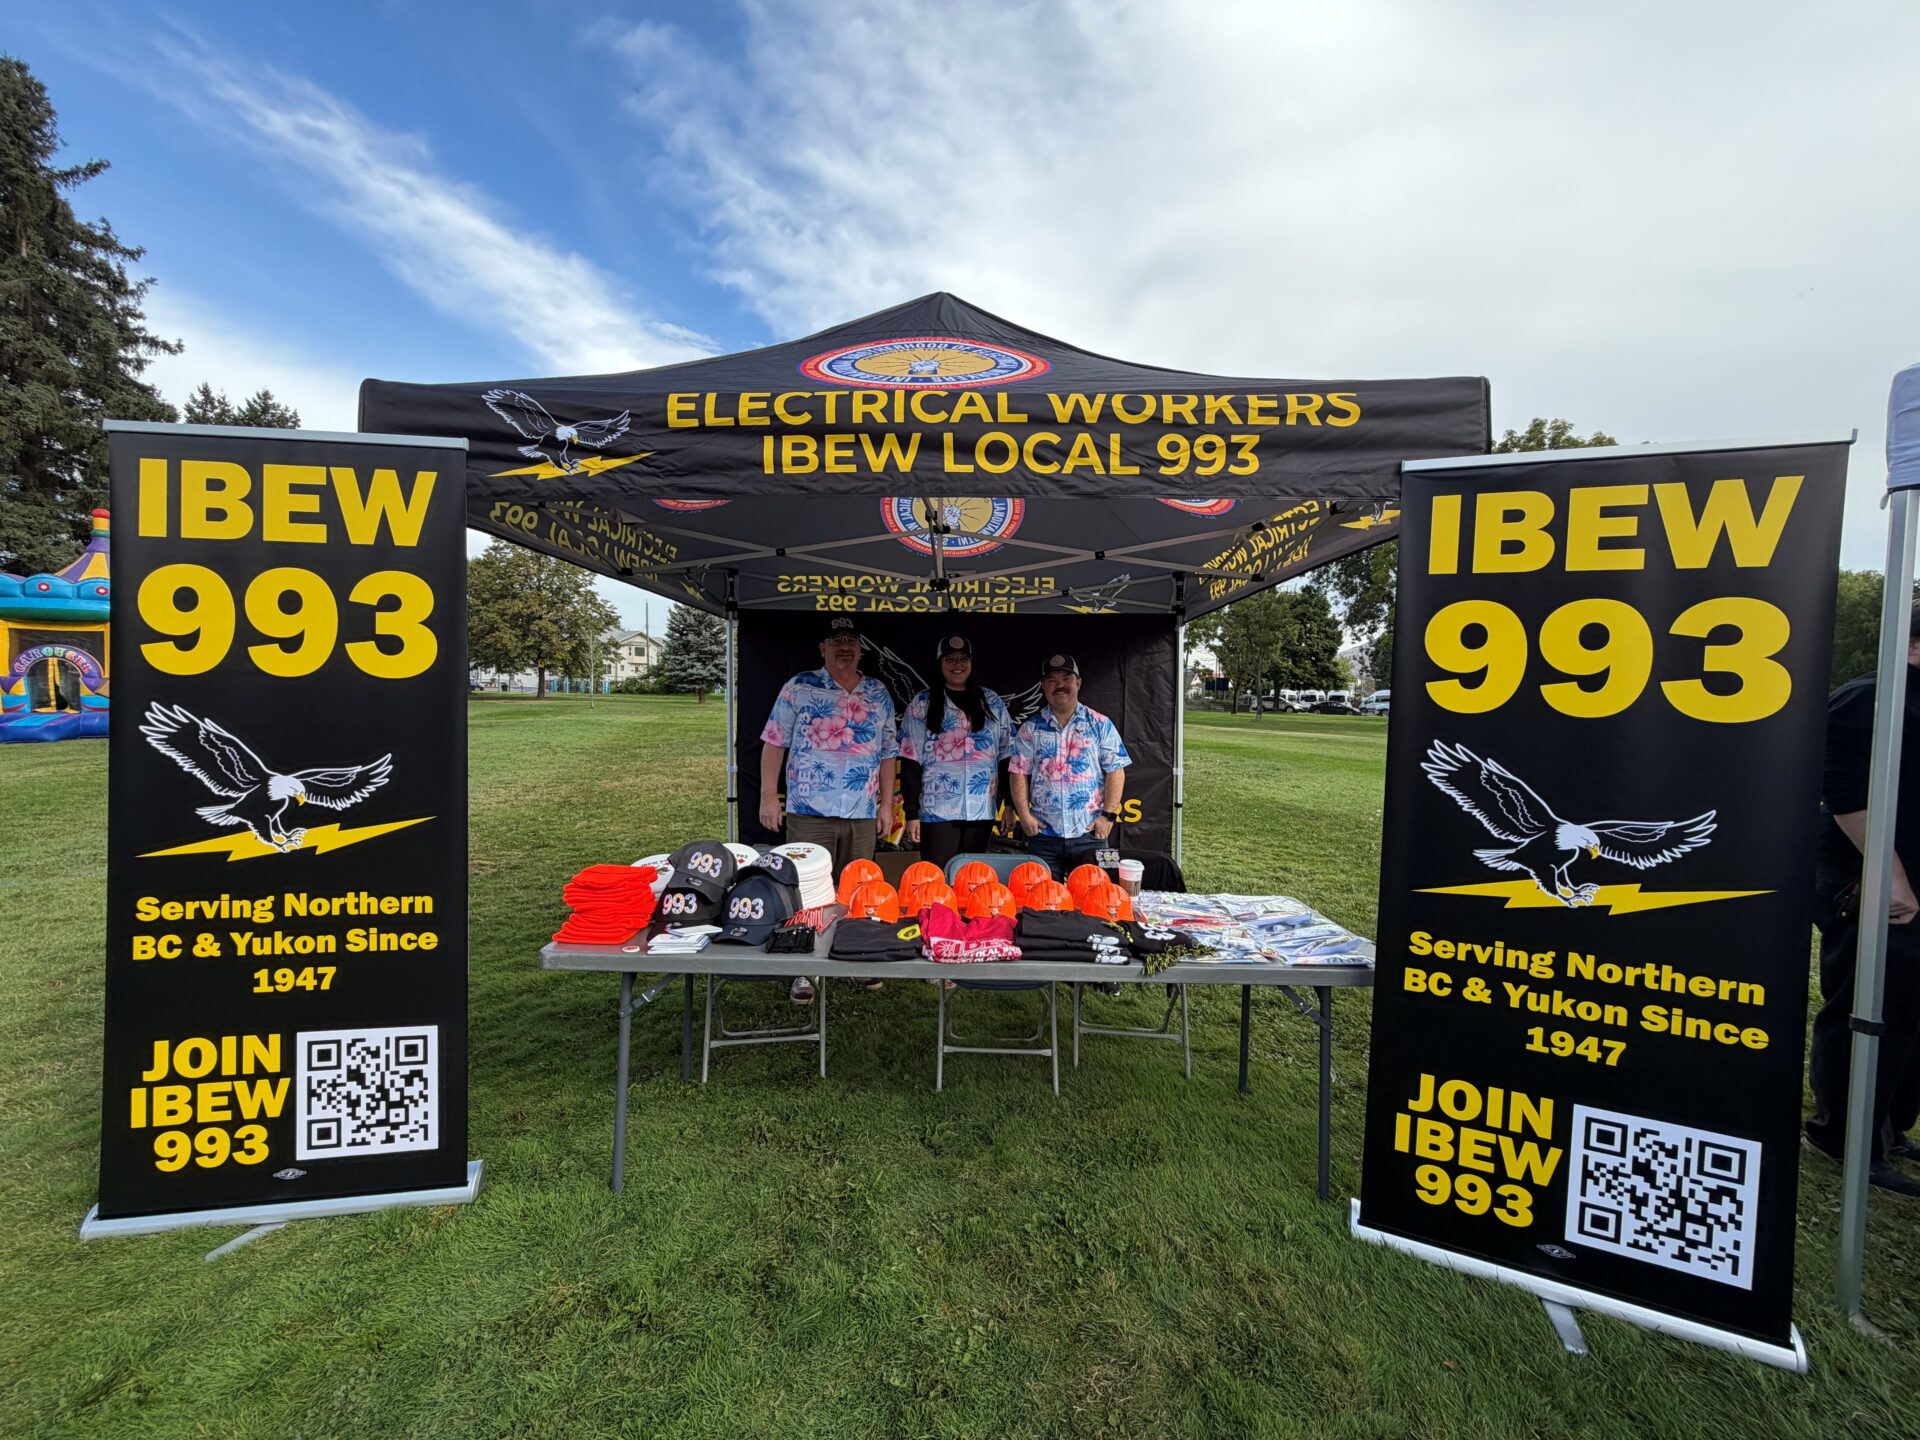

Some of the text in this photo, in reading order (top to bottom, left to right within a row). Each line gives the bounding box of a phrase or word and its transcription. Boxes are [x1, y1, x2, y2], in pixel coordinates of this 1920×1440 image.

[666, 389, 1362, 428] ELECTRICAL WORKERS
[762, 431, 1261, 477] IBEW LOCAL 993
[137, 457, 438, 547] IBEW
[1428, 476, 1805, 575] IBEW
[136, 563, 439, 680] 993
[1424, 596, 1793, 724] 993
[687, 851, 723, 878] 993
[136, 892, 433, 923] Serving Northern
[662, 892, 698, 916] 993
[728, 897, 764, 920] 993
[132, 928, 438, 960] BC & Yukon Since
[1408, 931, 1765, 1006] Serving Northern
[252, 966, 337, 993] 1947
[1403, 967, 1770, 1050] BC & Yukon Since
[142, 1033, 281, 1082] JOIN
[1525, 1026, 1627, 1067] 1947
[130, 1077, 291, 1129] IBEW
[1407, 1073, 1555, 1140] JOIN
[153, 1124, 270, 1173] 993
[1394, 1112, 1563, 1187] IBEW
[1415, 1164, 1534, 1228] 993
